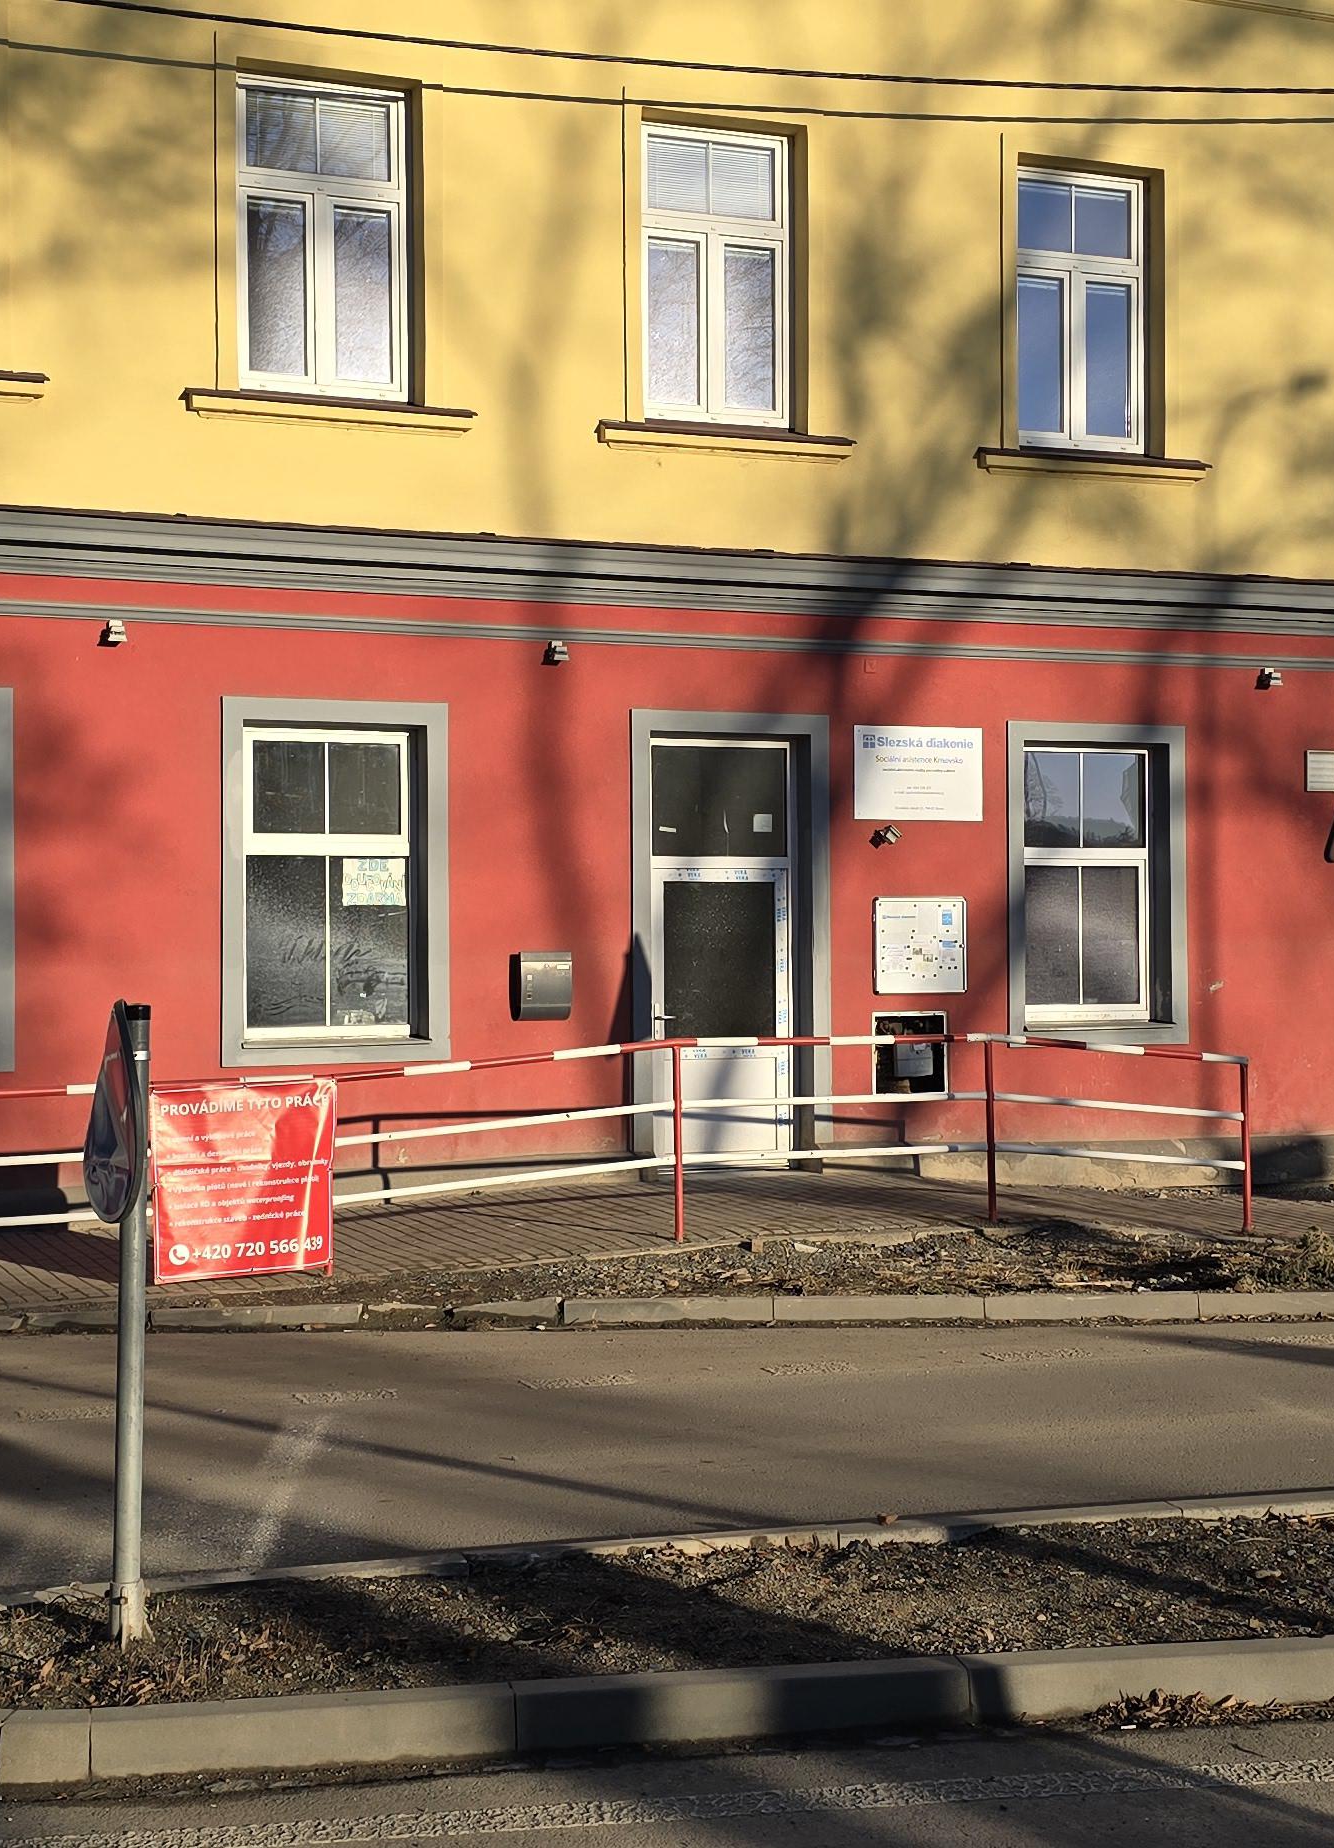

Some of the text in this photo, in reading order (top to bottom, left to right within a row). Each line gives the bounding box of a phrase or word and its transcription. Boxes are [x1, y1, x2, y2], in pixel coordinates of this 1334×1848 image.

[877, 737, 974, 749] Slezská diakonie
[358, 859, 389, 872] ZDE
[347, 892, 403, 905] ZDARMA
[247, 1097, 282, 1111] TYTO
[192, 1235, 323, 1260] +420 720 566 439
